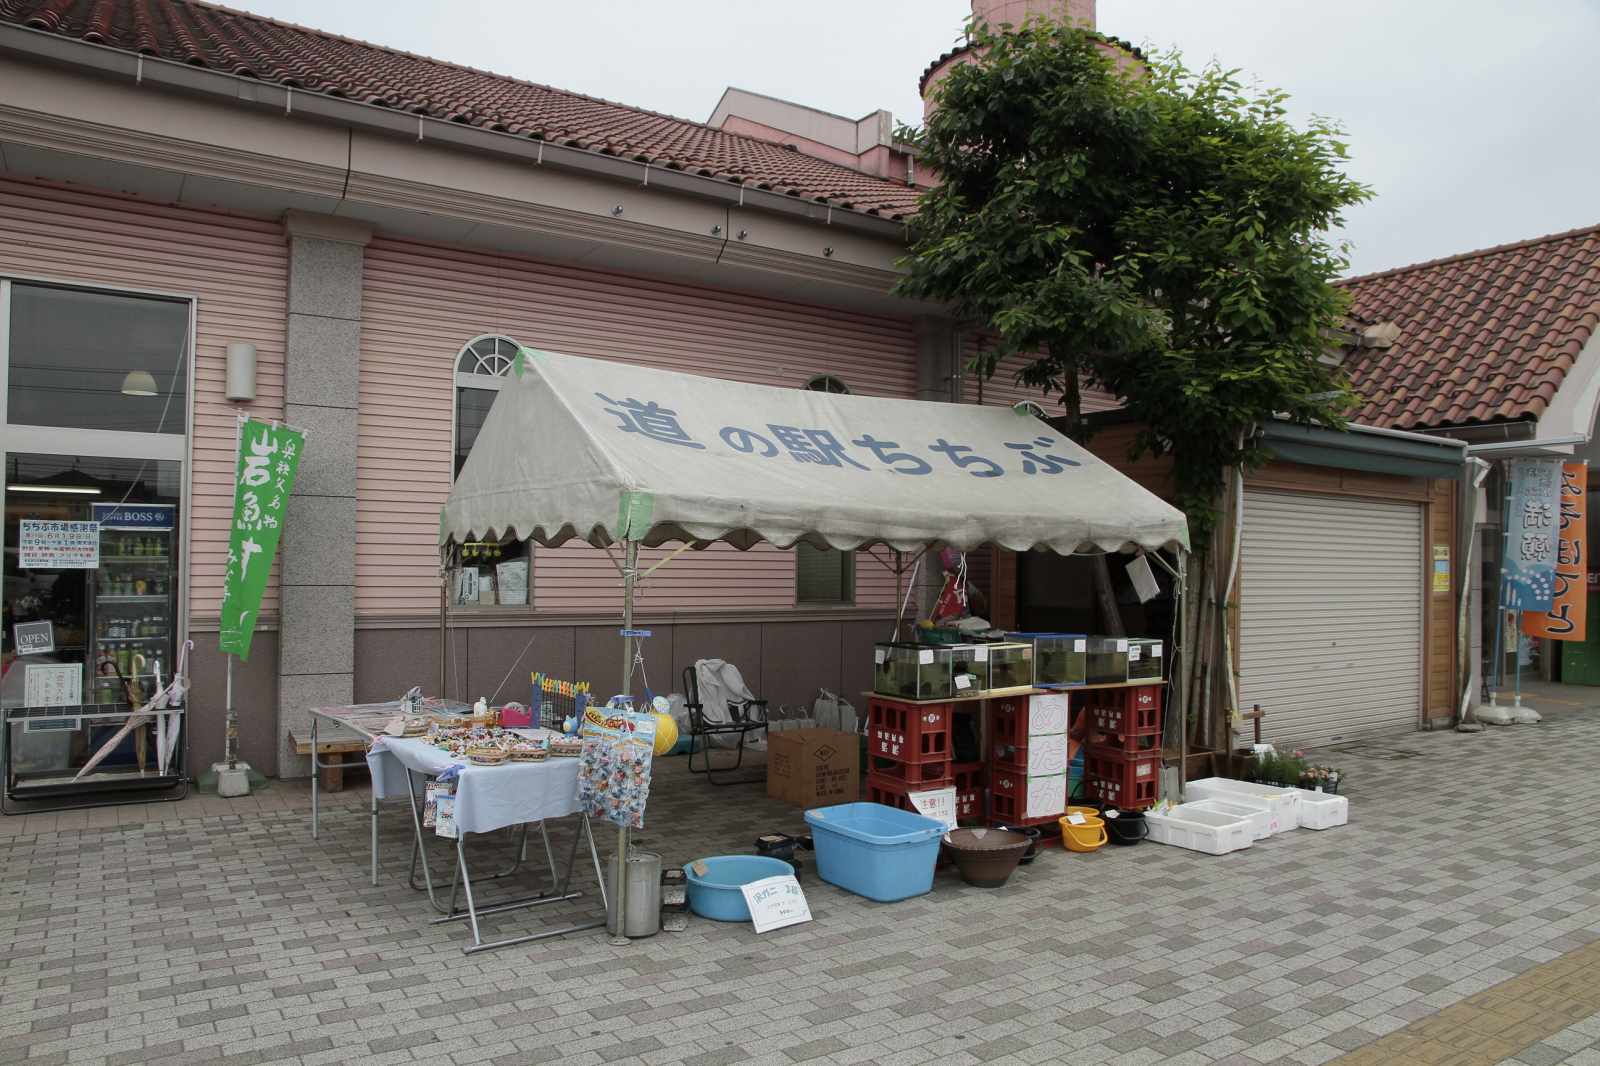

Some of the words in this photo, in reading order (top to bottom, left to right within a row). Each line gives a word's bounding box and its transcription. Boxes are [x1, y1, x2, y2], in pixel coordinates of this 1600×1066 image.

[594, 392, 1082, 477] 道の駅ちちぶ
[124, 511, 153, 521] BOSS
[20, 632, 49, 645] OPEN
[1031, 701, 1065, 811] めだか
